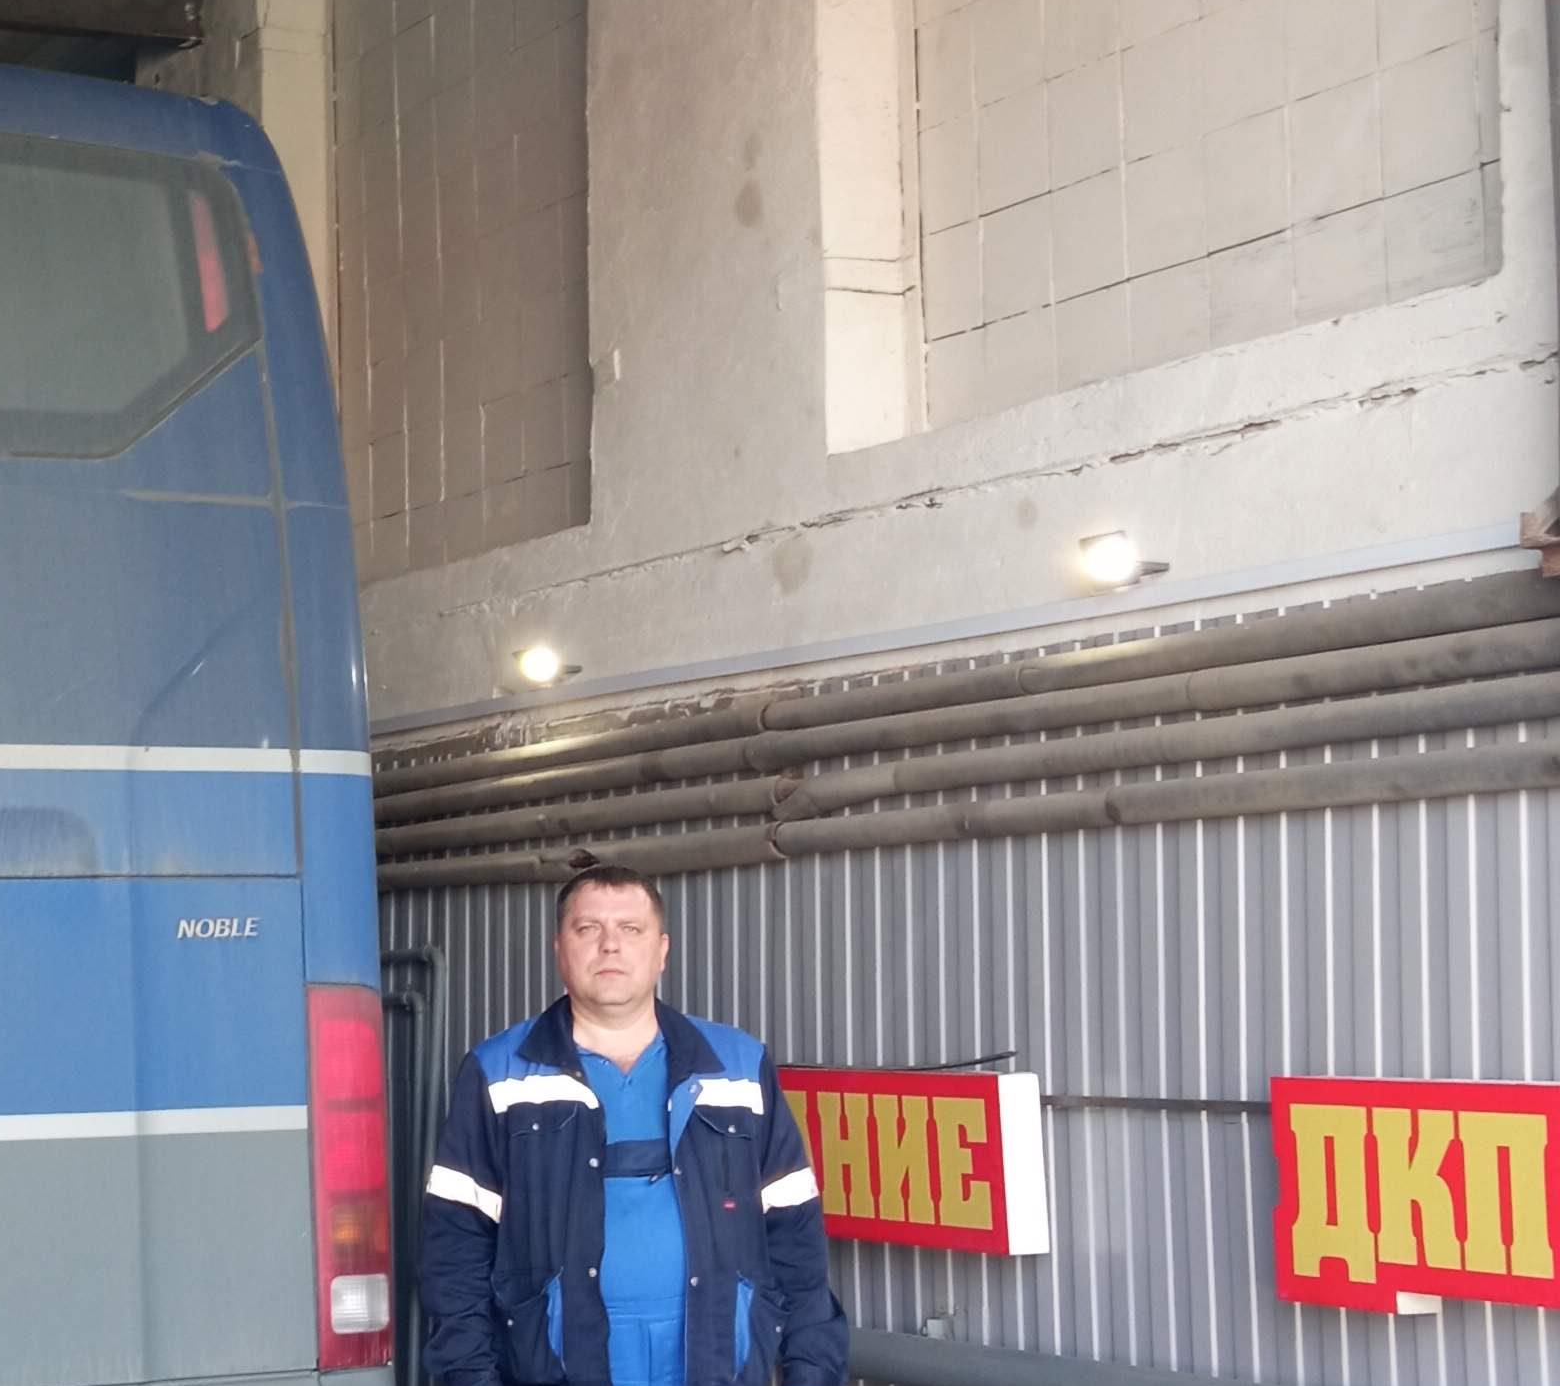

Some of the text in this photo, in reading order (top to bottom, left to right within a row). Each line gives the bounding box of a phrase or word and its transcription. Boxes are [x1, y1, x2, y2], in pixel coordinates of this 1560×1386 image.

[177, 917, 261, 939] NOBLE
[783, 1089, 994, 1231] НИЕ
[1289, 1103, 1555, 1284] ДКП
